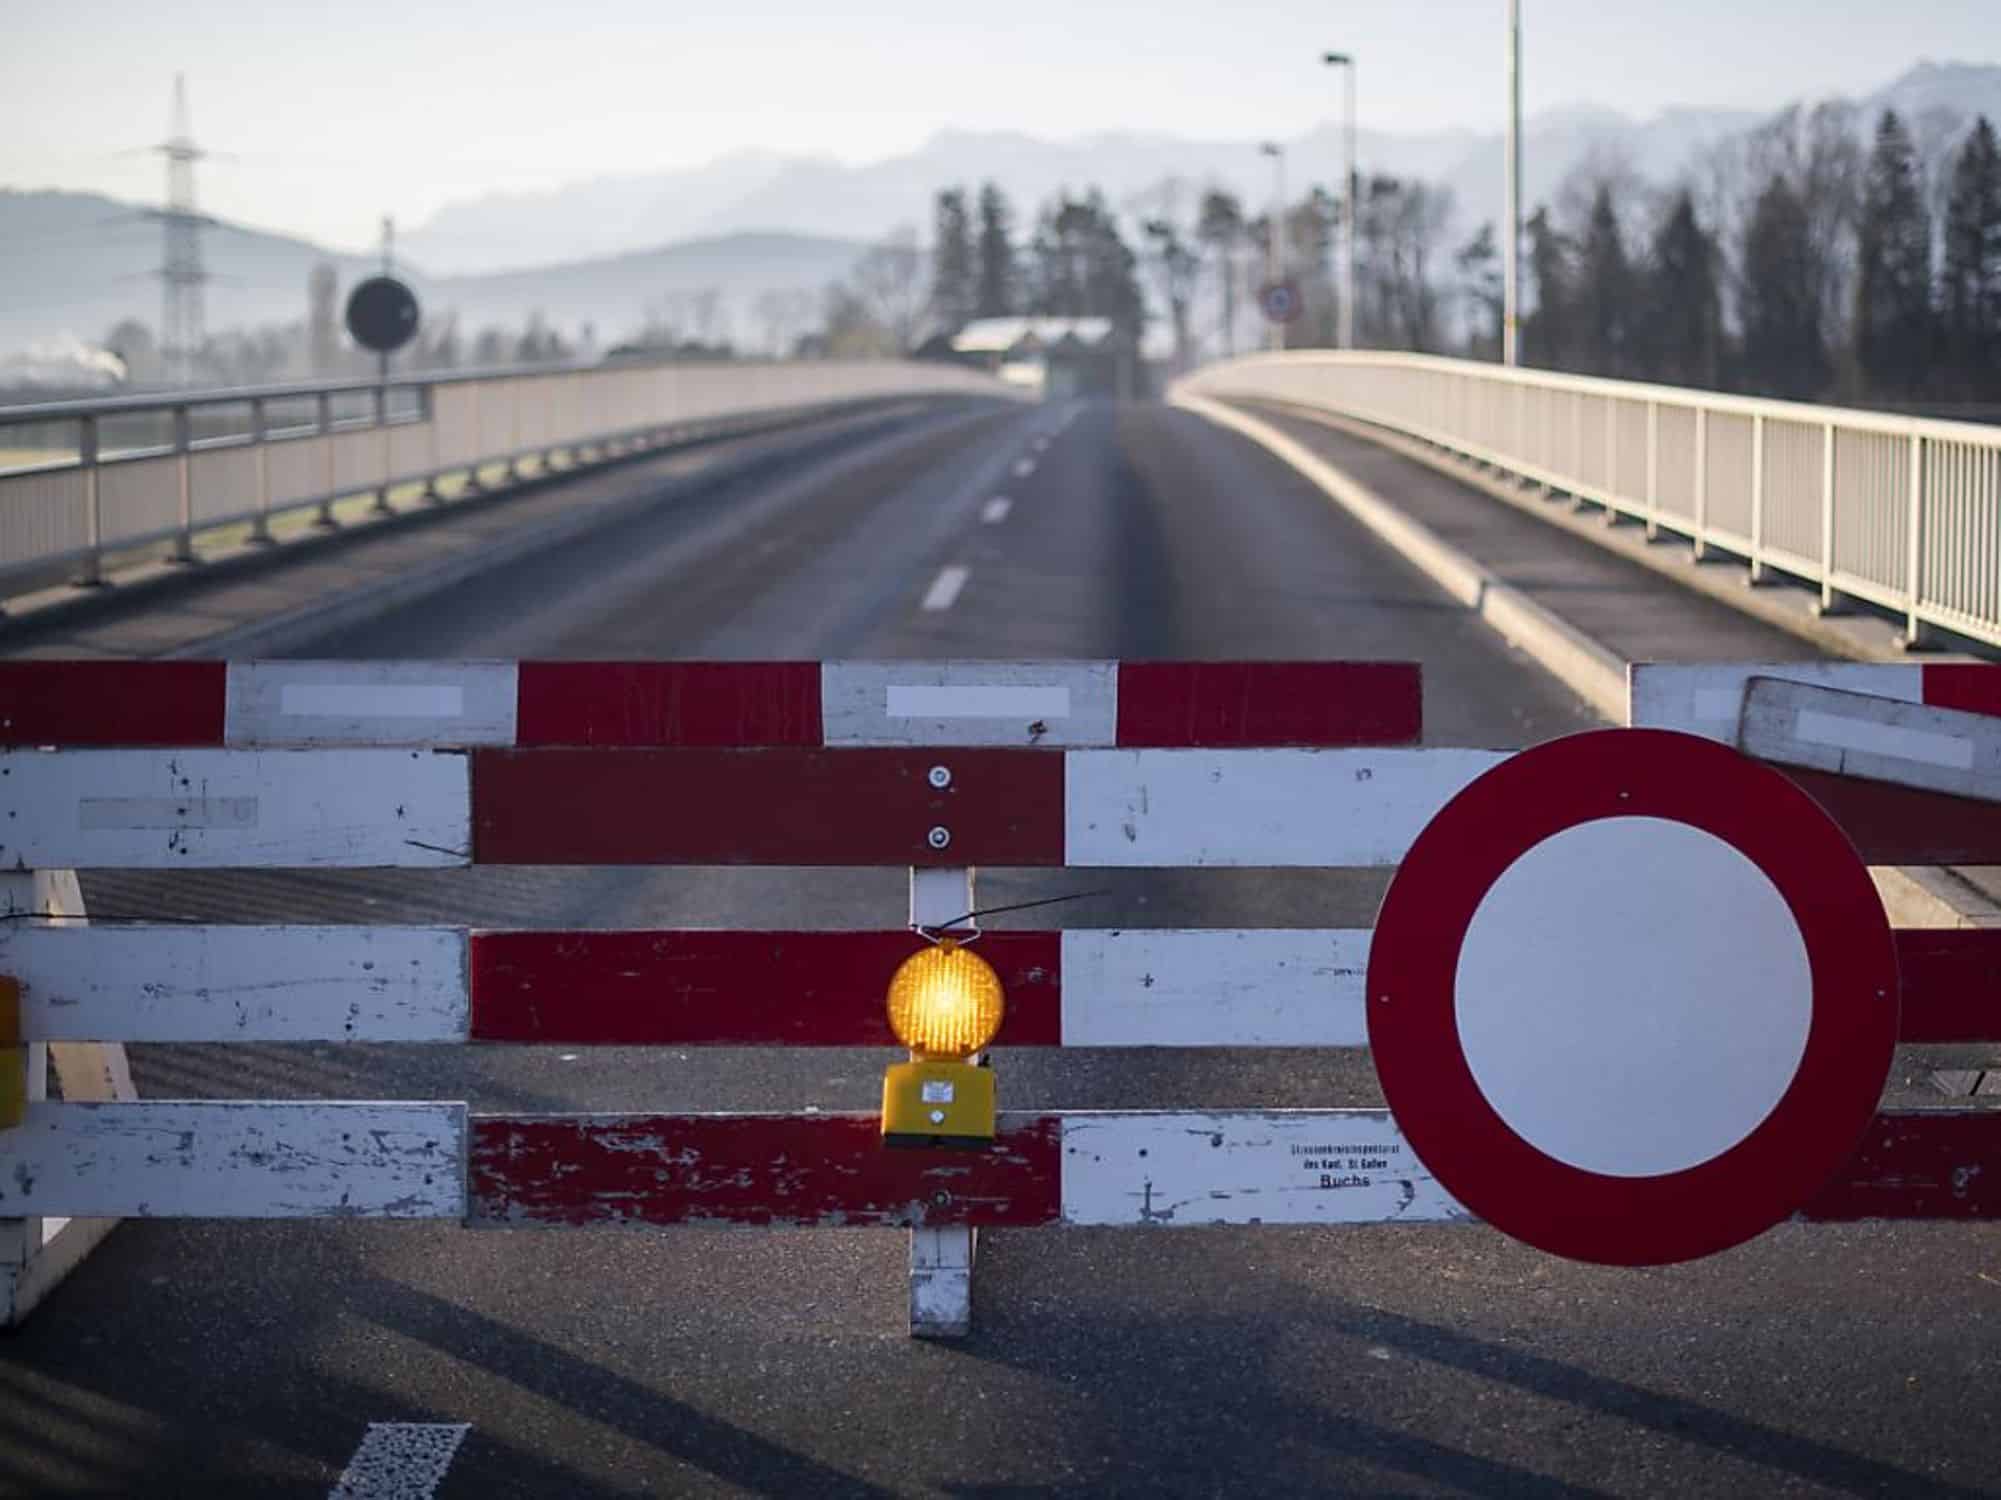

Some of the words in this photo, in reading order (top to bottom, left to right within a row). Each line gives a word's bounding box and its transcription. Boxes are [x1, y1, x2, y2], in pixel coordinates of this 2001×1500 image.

[1303, 1158, 1318, 1169] des
[1361, 1158, 1388, 1169] Gallen
[1319, 1173, 1371, 1188] Buchs
